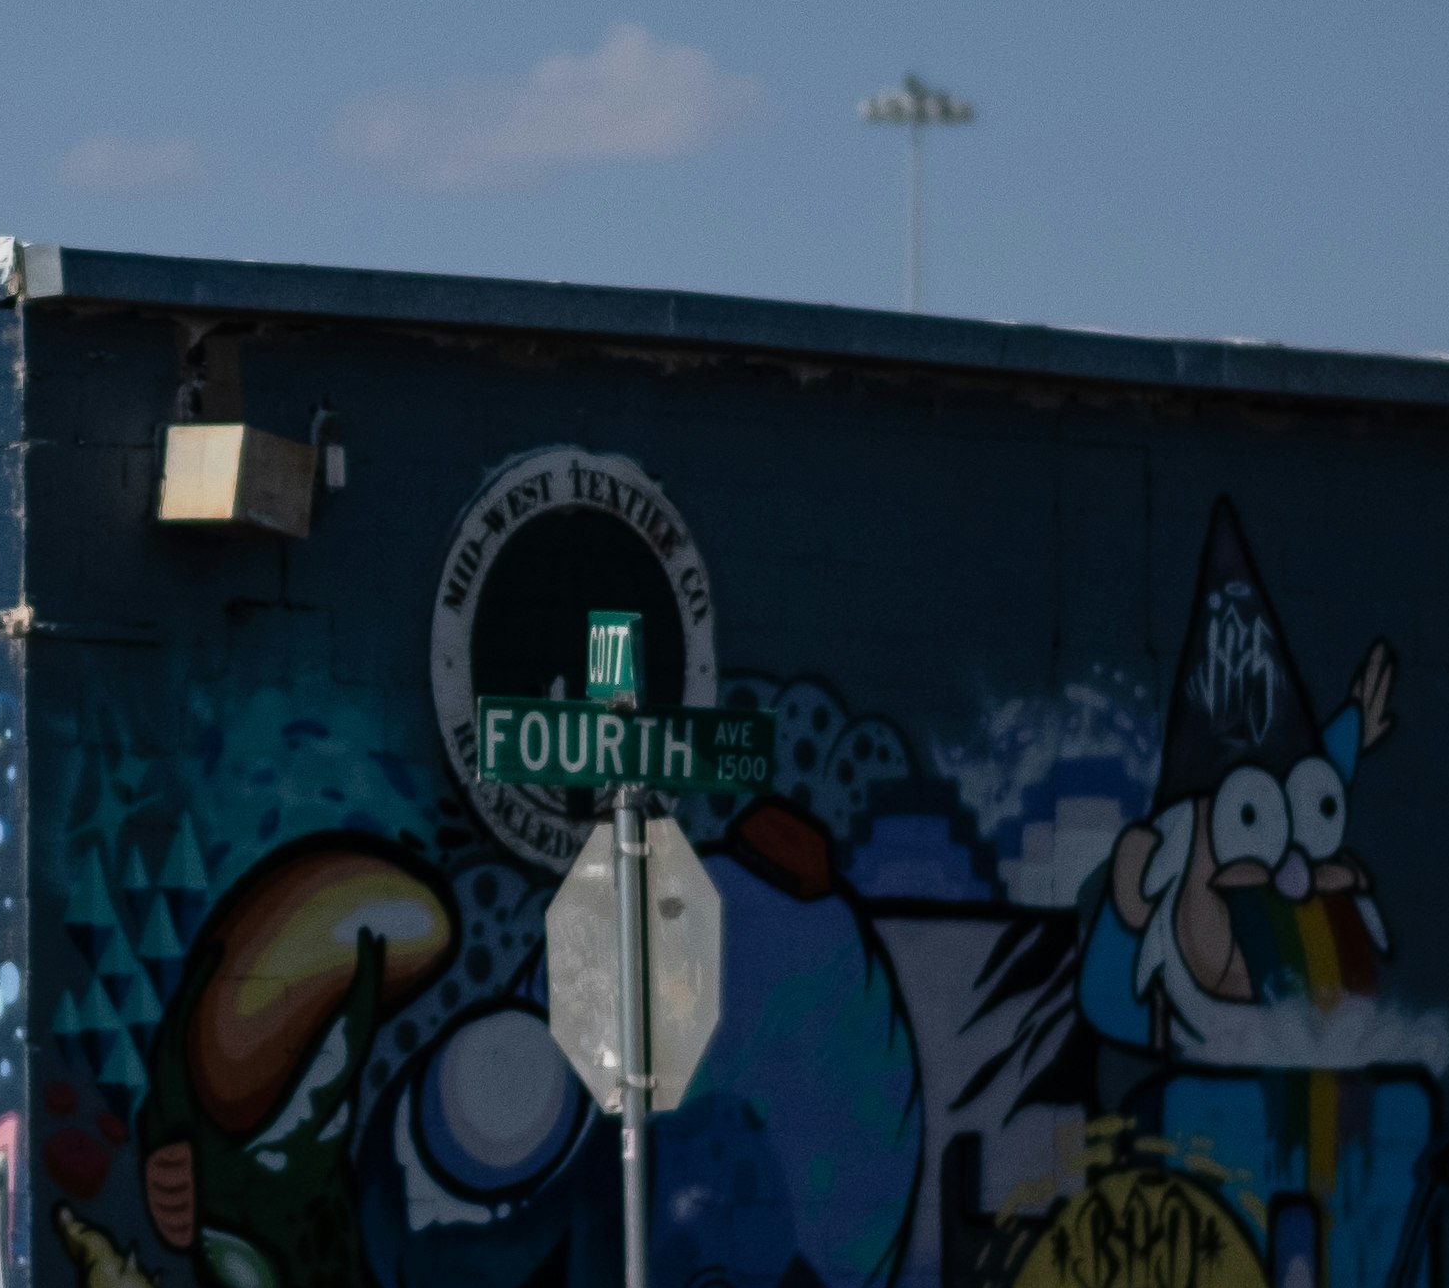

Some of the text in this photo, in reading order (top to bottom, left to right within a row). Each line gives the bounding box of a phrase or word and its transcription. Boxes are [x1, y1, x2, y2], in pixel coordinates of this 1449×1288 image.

[444, 472, 552, 611] MID-WEST
[485, 708, 753, 778] FOURTH AVE
[716, 754, 768, 782] 1500
